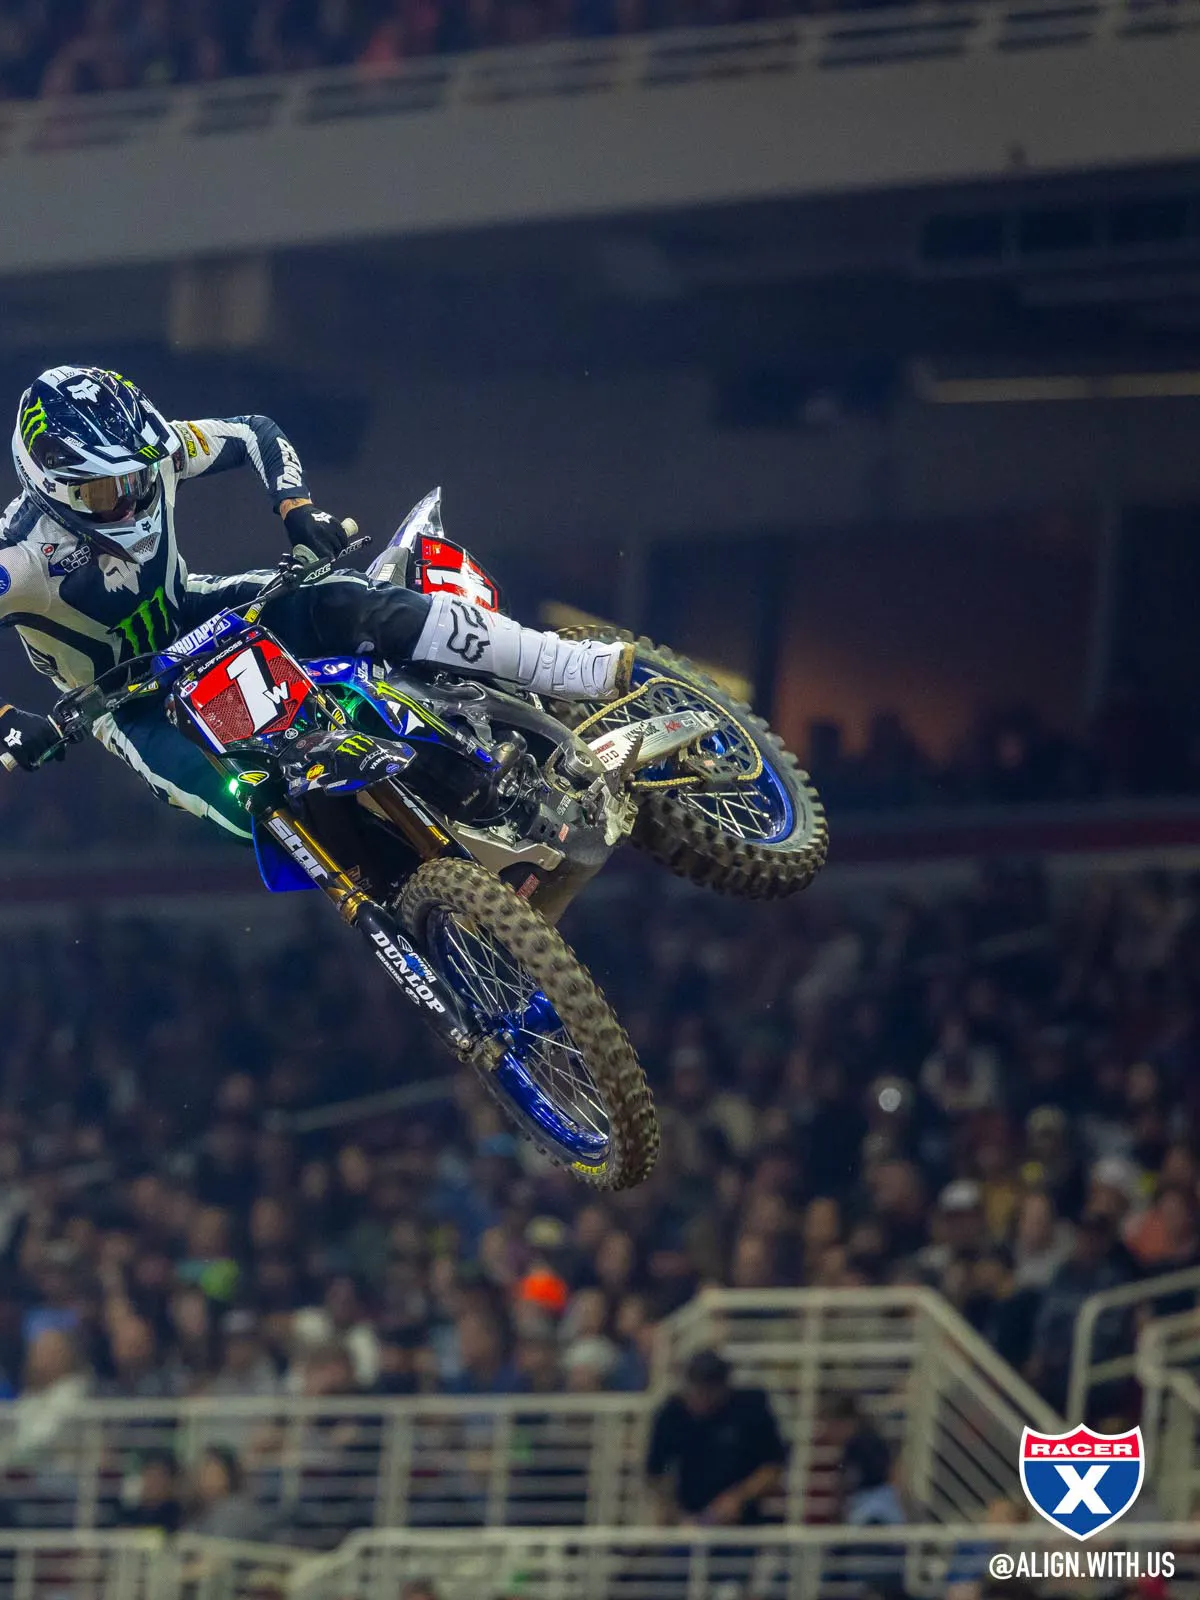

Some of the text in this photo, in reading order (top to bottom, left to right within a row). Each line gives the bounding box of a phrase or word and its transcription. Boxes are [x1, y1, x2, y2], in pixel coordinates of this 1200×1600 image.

[60, 545, 90, 567] QUAD
[303, 563, 332, 582] ARC
[197, 640, 243, 674] SUPERCROSS
[226, 647, 290, 734] 1 W
[599, 749, 620, 764] DID
[370, 930, 446, 1013] DUNLOP
[375, 950, 404, 984] BRAKING
